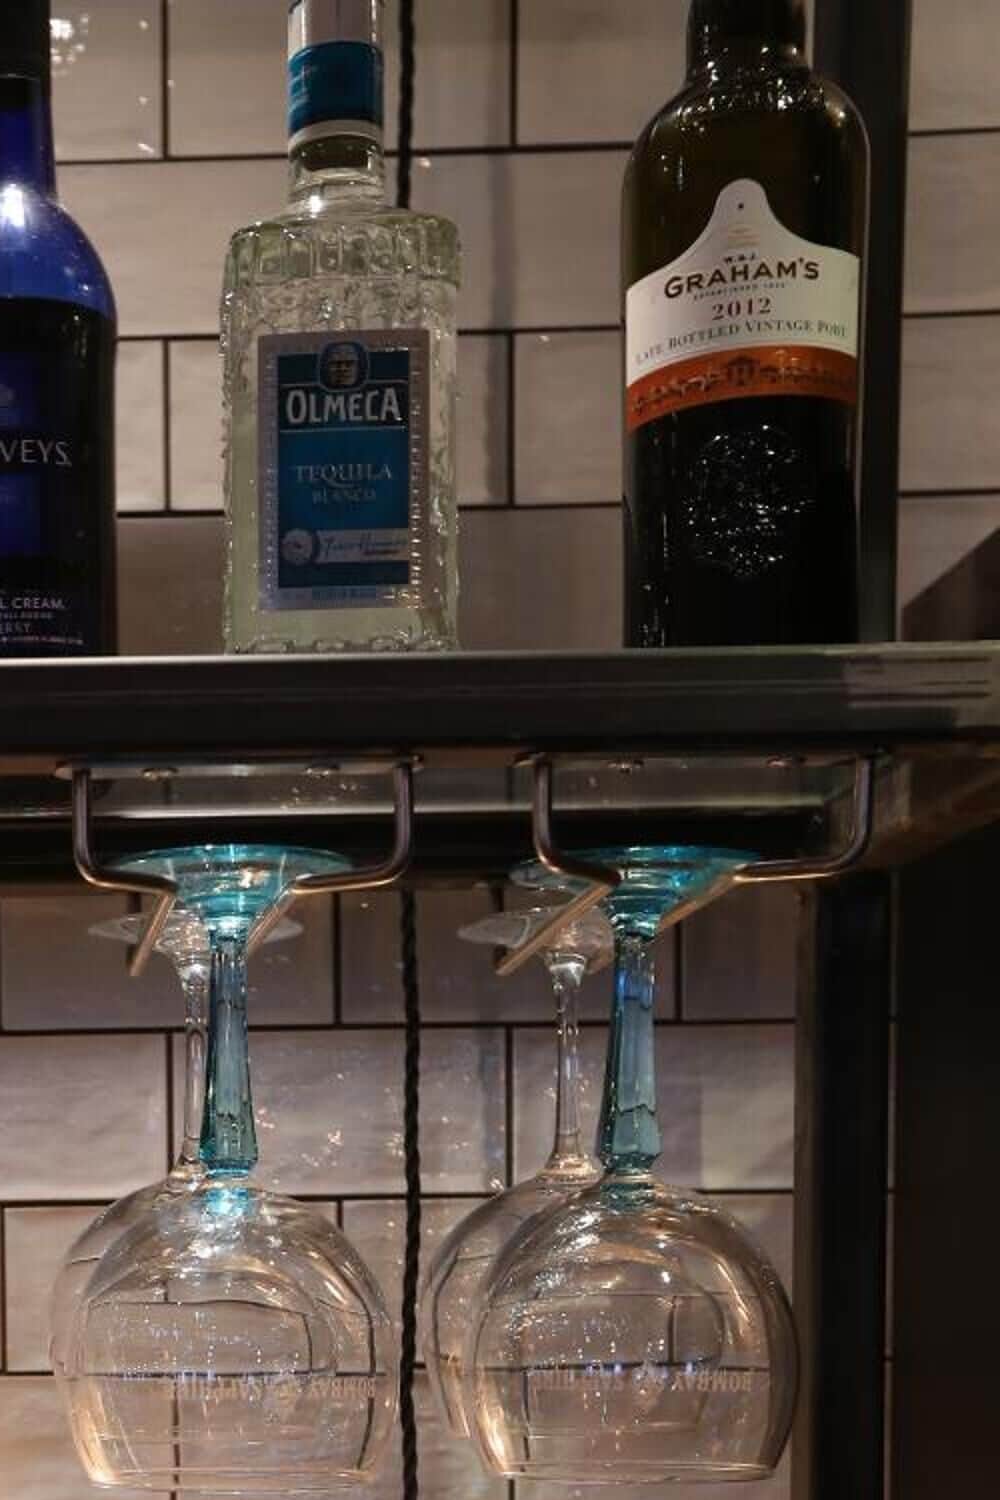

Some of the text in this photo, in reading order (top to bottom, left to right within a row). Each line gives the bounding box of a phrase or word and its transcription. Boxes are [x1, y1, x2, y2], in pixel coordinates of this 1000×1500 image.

[664, 257, 820, 299] GRAHAM'S
[712, 298, 771, 320] 2012
[669, 325, 740, 349] BOTTLED
[744, 319, 812, 334] VINTAGE
[286, 387, 401, 424] OLMECA
[294, 463, 392, 488] TEQUILA
